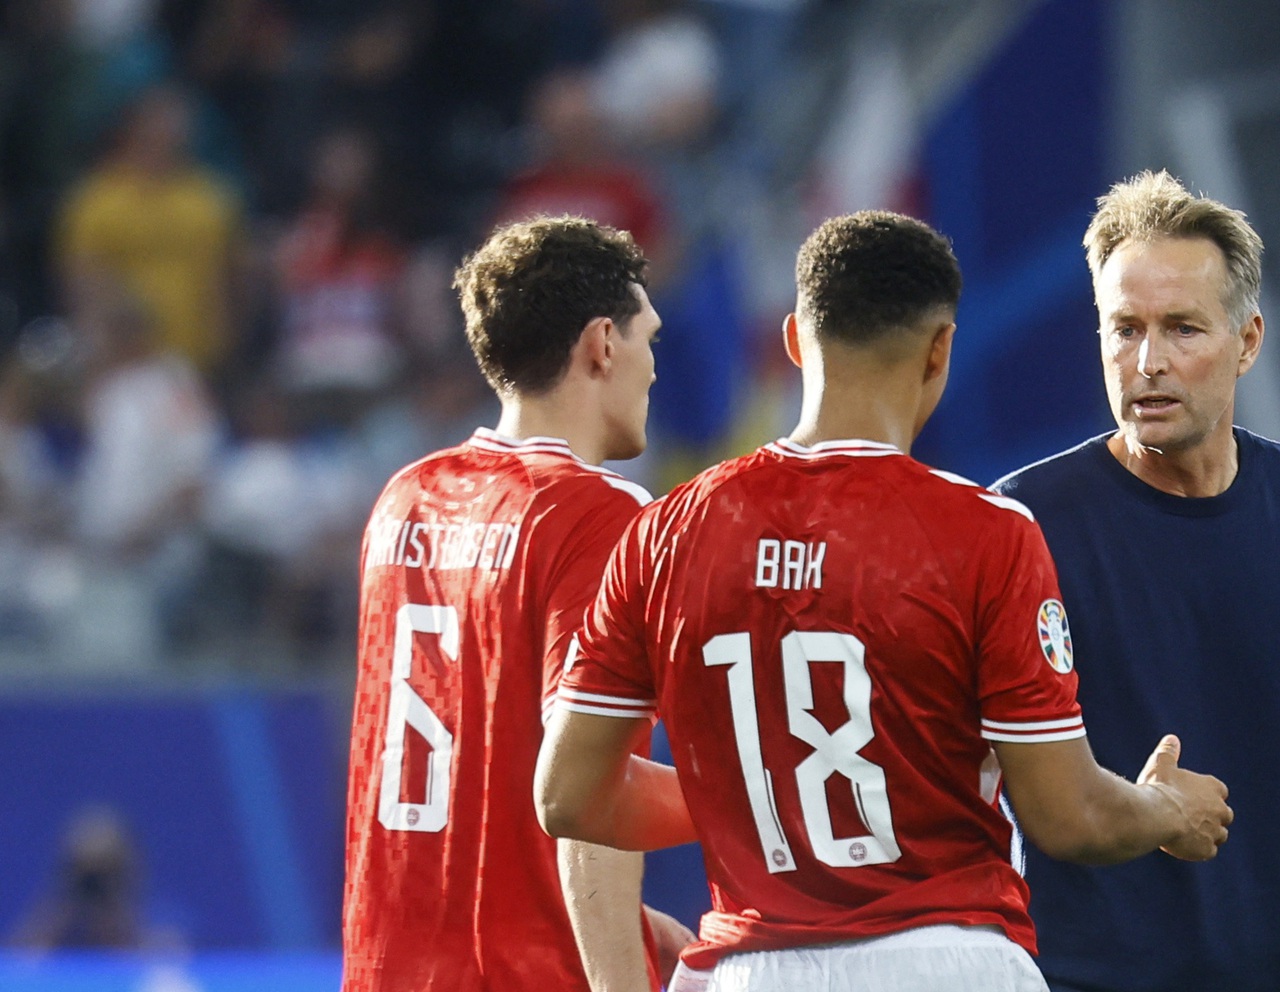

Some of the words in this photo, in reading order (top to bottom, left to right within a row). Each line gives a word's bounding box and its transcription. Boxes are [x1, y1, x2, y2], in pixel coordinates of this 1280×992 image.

[755, 538, 827, 591] BAK
[378, 603, 459, 833] 6
[702, 630, 902, 874] 18
